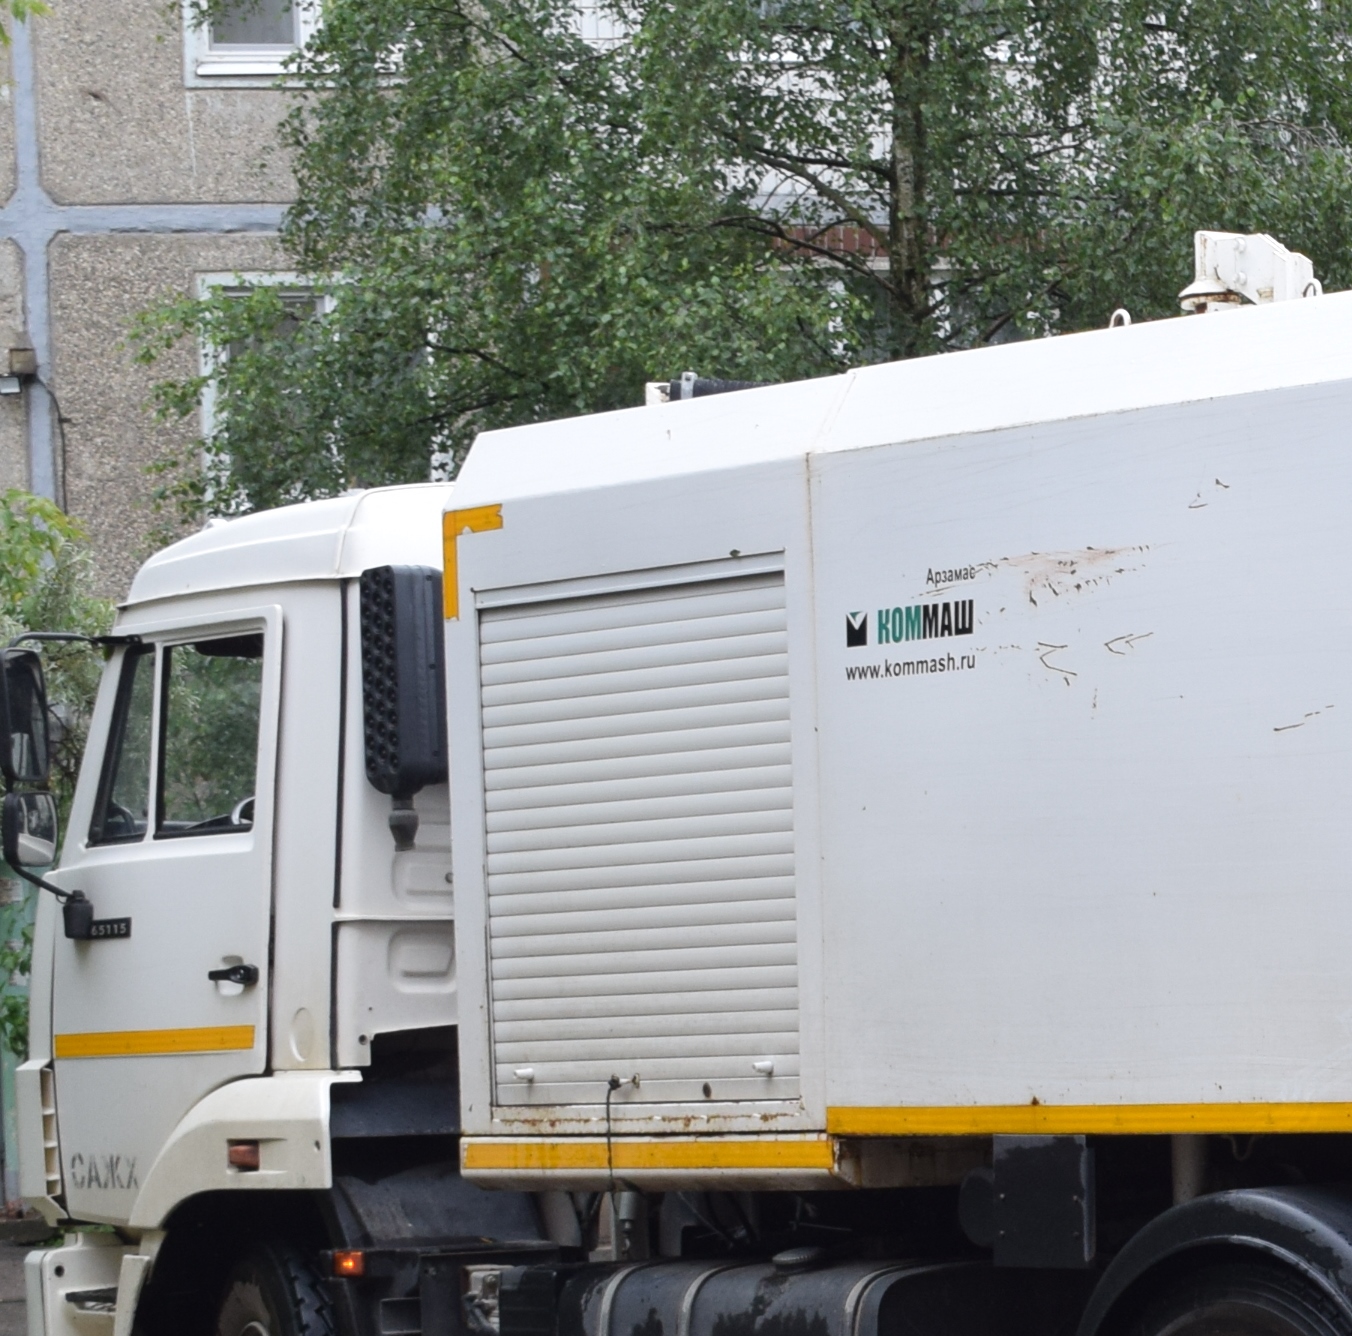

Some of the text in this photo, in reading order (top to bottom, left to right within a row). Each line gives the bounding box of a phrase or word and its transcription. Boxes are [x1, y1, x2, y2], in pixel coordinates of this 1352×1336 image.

[926, 566, 976, 588] Арзамас
[877, 599, 975, 645] КОММАШ
[845, 652, 976, 681] www.kommash.ru
[91, 923, 127, 936] 65115
